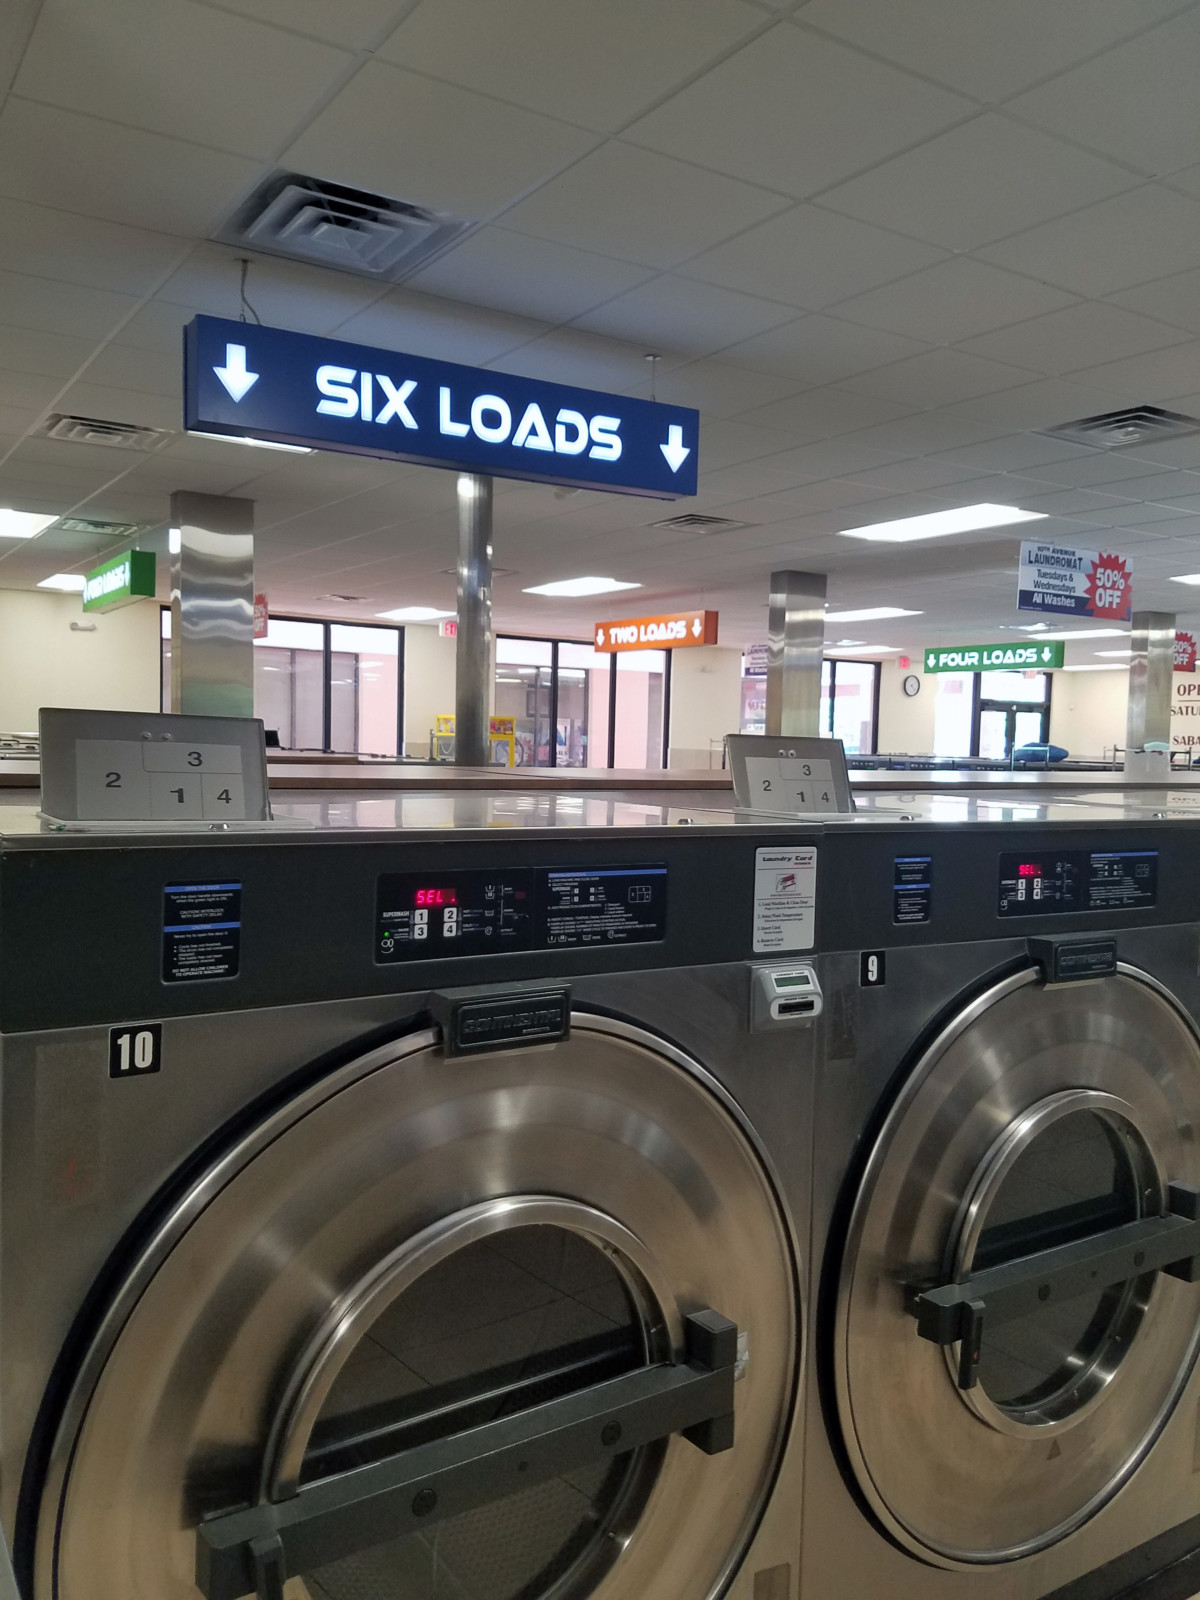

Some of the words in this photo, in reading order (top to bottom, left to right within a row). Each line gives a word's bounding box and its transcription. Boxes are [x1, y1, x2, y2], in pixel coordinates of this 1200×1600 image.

[315, 364, 418, 430] SIX
[439, 386, 622, 462] LOADS
[1028, 550, 1083, 571] LAUNDROMAT
[1037, 569, 1068, 582] Tuesdays
[1068, 573, 1074, 582] &
[1095, 567, 1125, 590] 50%
[1033, 580, 1076, 594] Wednesdays
[1032, 592, 1043, 604] All
[1044, 593, 1076, 608] Washes
[1095, 588, 1121, 609] OFF
[609, 625, 638, 645] TWO
[640, 620, 687, 642] LOADS
[939, 651, 979, 667] FOUR
[983, 648, 1038, 665] LOADS
[187, 751, 203, 767] 3
[802, 764, 812, 776] 3
[105, 772, 122, 788] 2
[762, 780, 772, 792] 2
[169, 788, 184, 804] 1
[216, 789, 232, 804] 4
[796, 791, 806, 803] 1
[821, 792, 830, 803] 4
[867, 954, 878, 982] 9
[117, 1031, 153, 1070] 10
